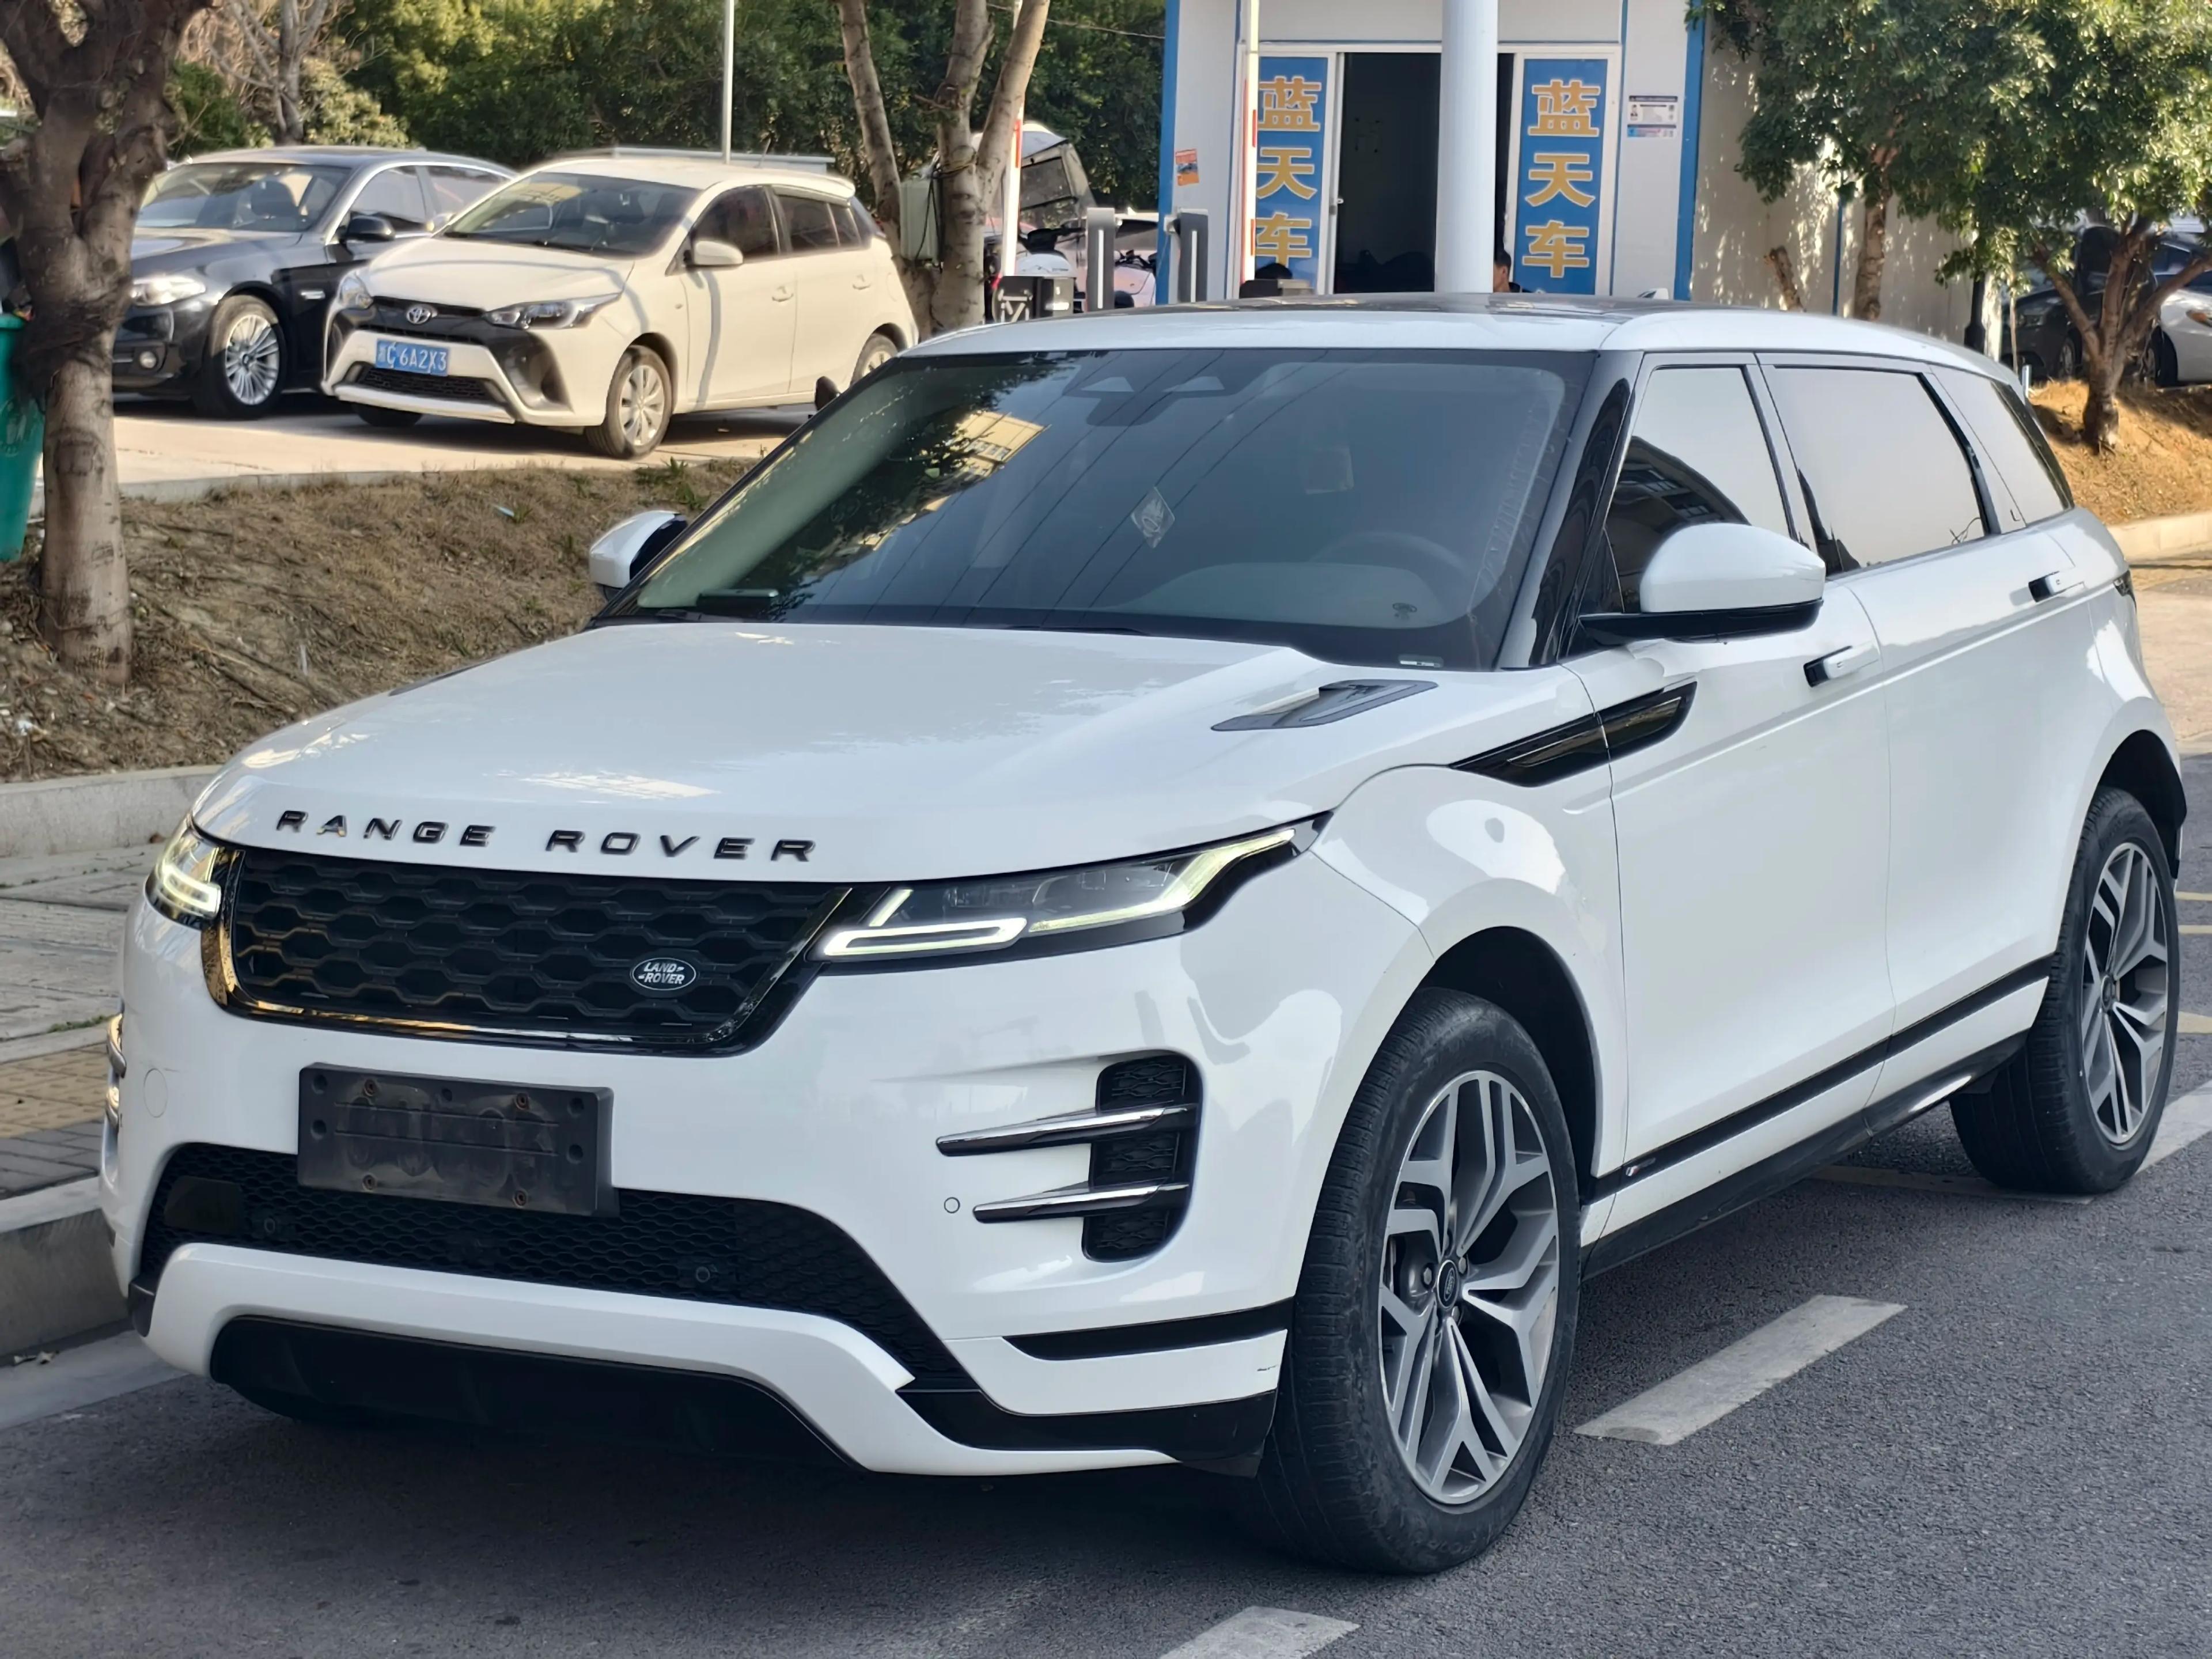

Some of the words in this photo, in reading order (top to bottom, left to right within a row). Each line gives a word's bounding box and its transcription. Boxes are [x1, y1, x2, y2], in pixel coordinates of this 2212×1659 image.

[276, 810, 496, 847] RANGE
[546, 830, 816, 862] ROVER
[643, 962, 677, 972] LAND
[644, 972, 685, 984] ROVER
